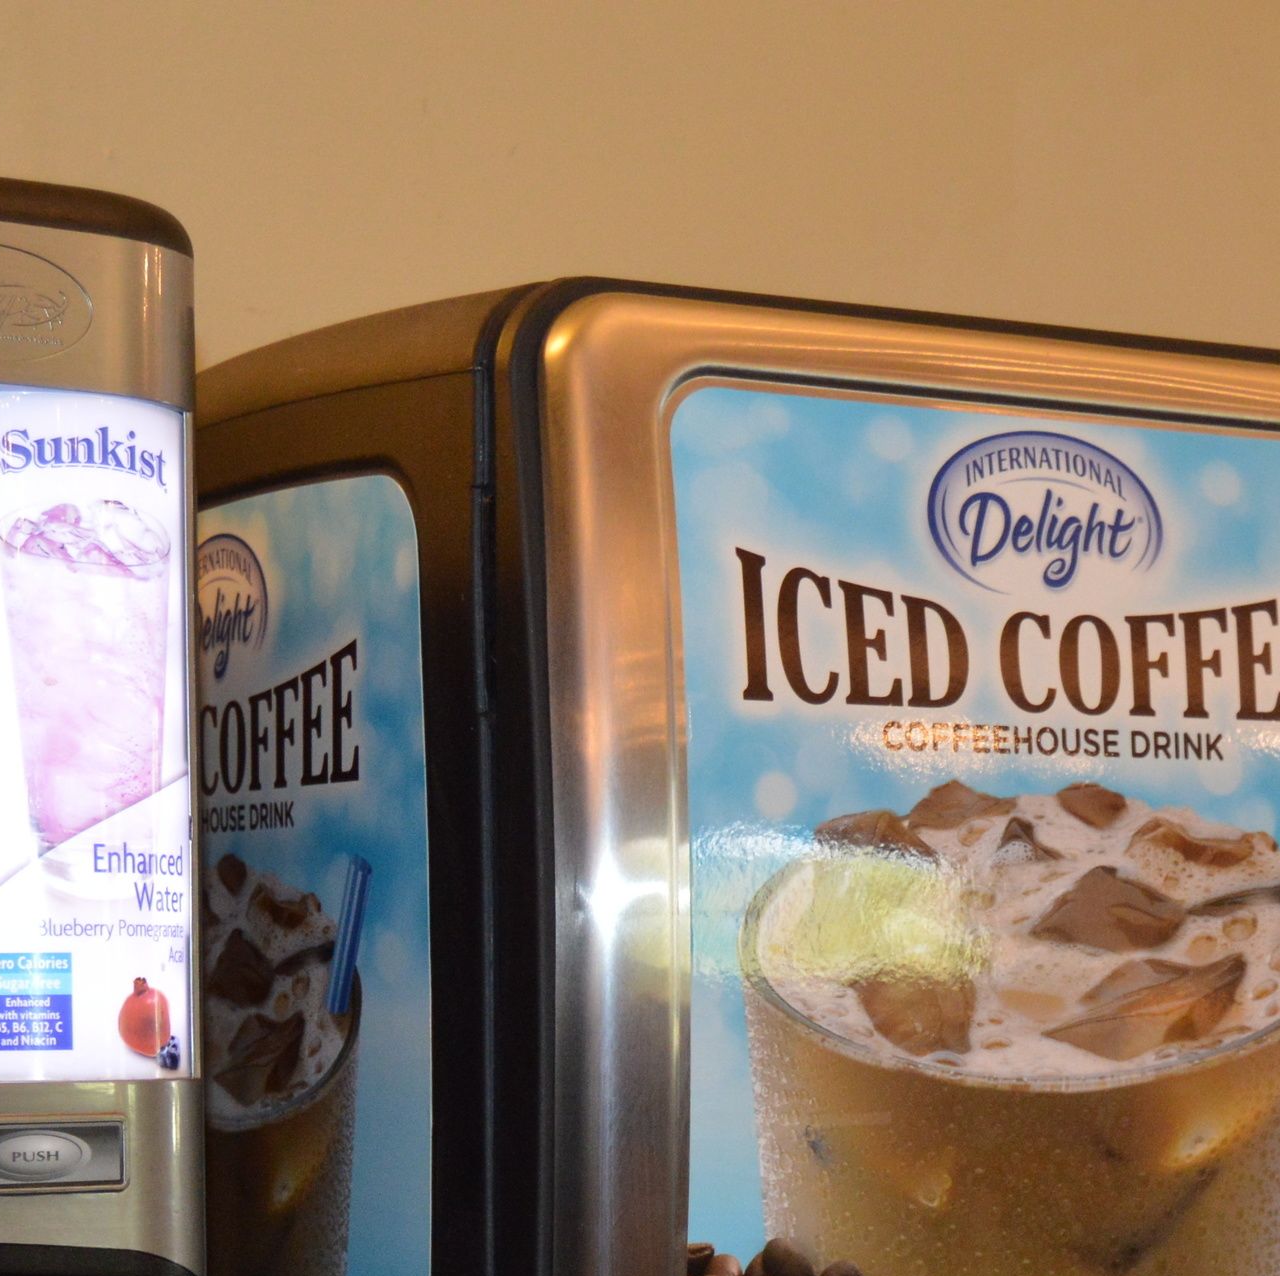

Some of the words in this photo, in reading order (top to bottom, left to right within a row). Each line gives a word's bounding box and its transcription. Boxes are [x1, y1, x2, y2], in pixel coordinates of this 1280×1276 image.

[0, 426, 167, 487] Sunkist
[965, 446, 1127, 501] INTERNATIONAL
[959, 488, 1135, 588] Delight
[198, 588, 256, 680] elight
[735, 546, 970, 709] ICED
[200, 638, 360, 796] COFFEE
[882, 720, 1121, 757] COFFEEHOUSE
[1130, 729, 1224, 761] DRINK
[249, 801, 295, 831] DRINK
[93, 842, 183, 876] Enhanced
[134, 881, 184, 912] Water
[40, 918, 114, 942] Blueberry
[18, 956, 68, 970] Calories
[33, 975, 61, 989] ree
[5, 997, 51, 1007] Enhanced
[20, 1010, 60, 1020] vitamins
[1, 1036, 19, 1046] and
[21, 1035, 56, 1046] Niacin
[55, 1022, 63, 1032] C
[11, 1149, 60, 1164] PUSH
